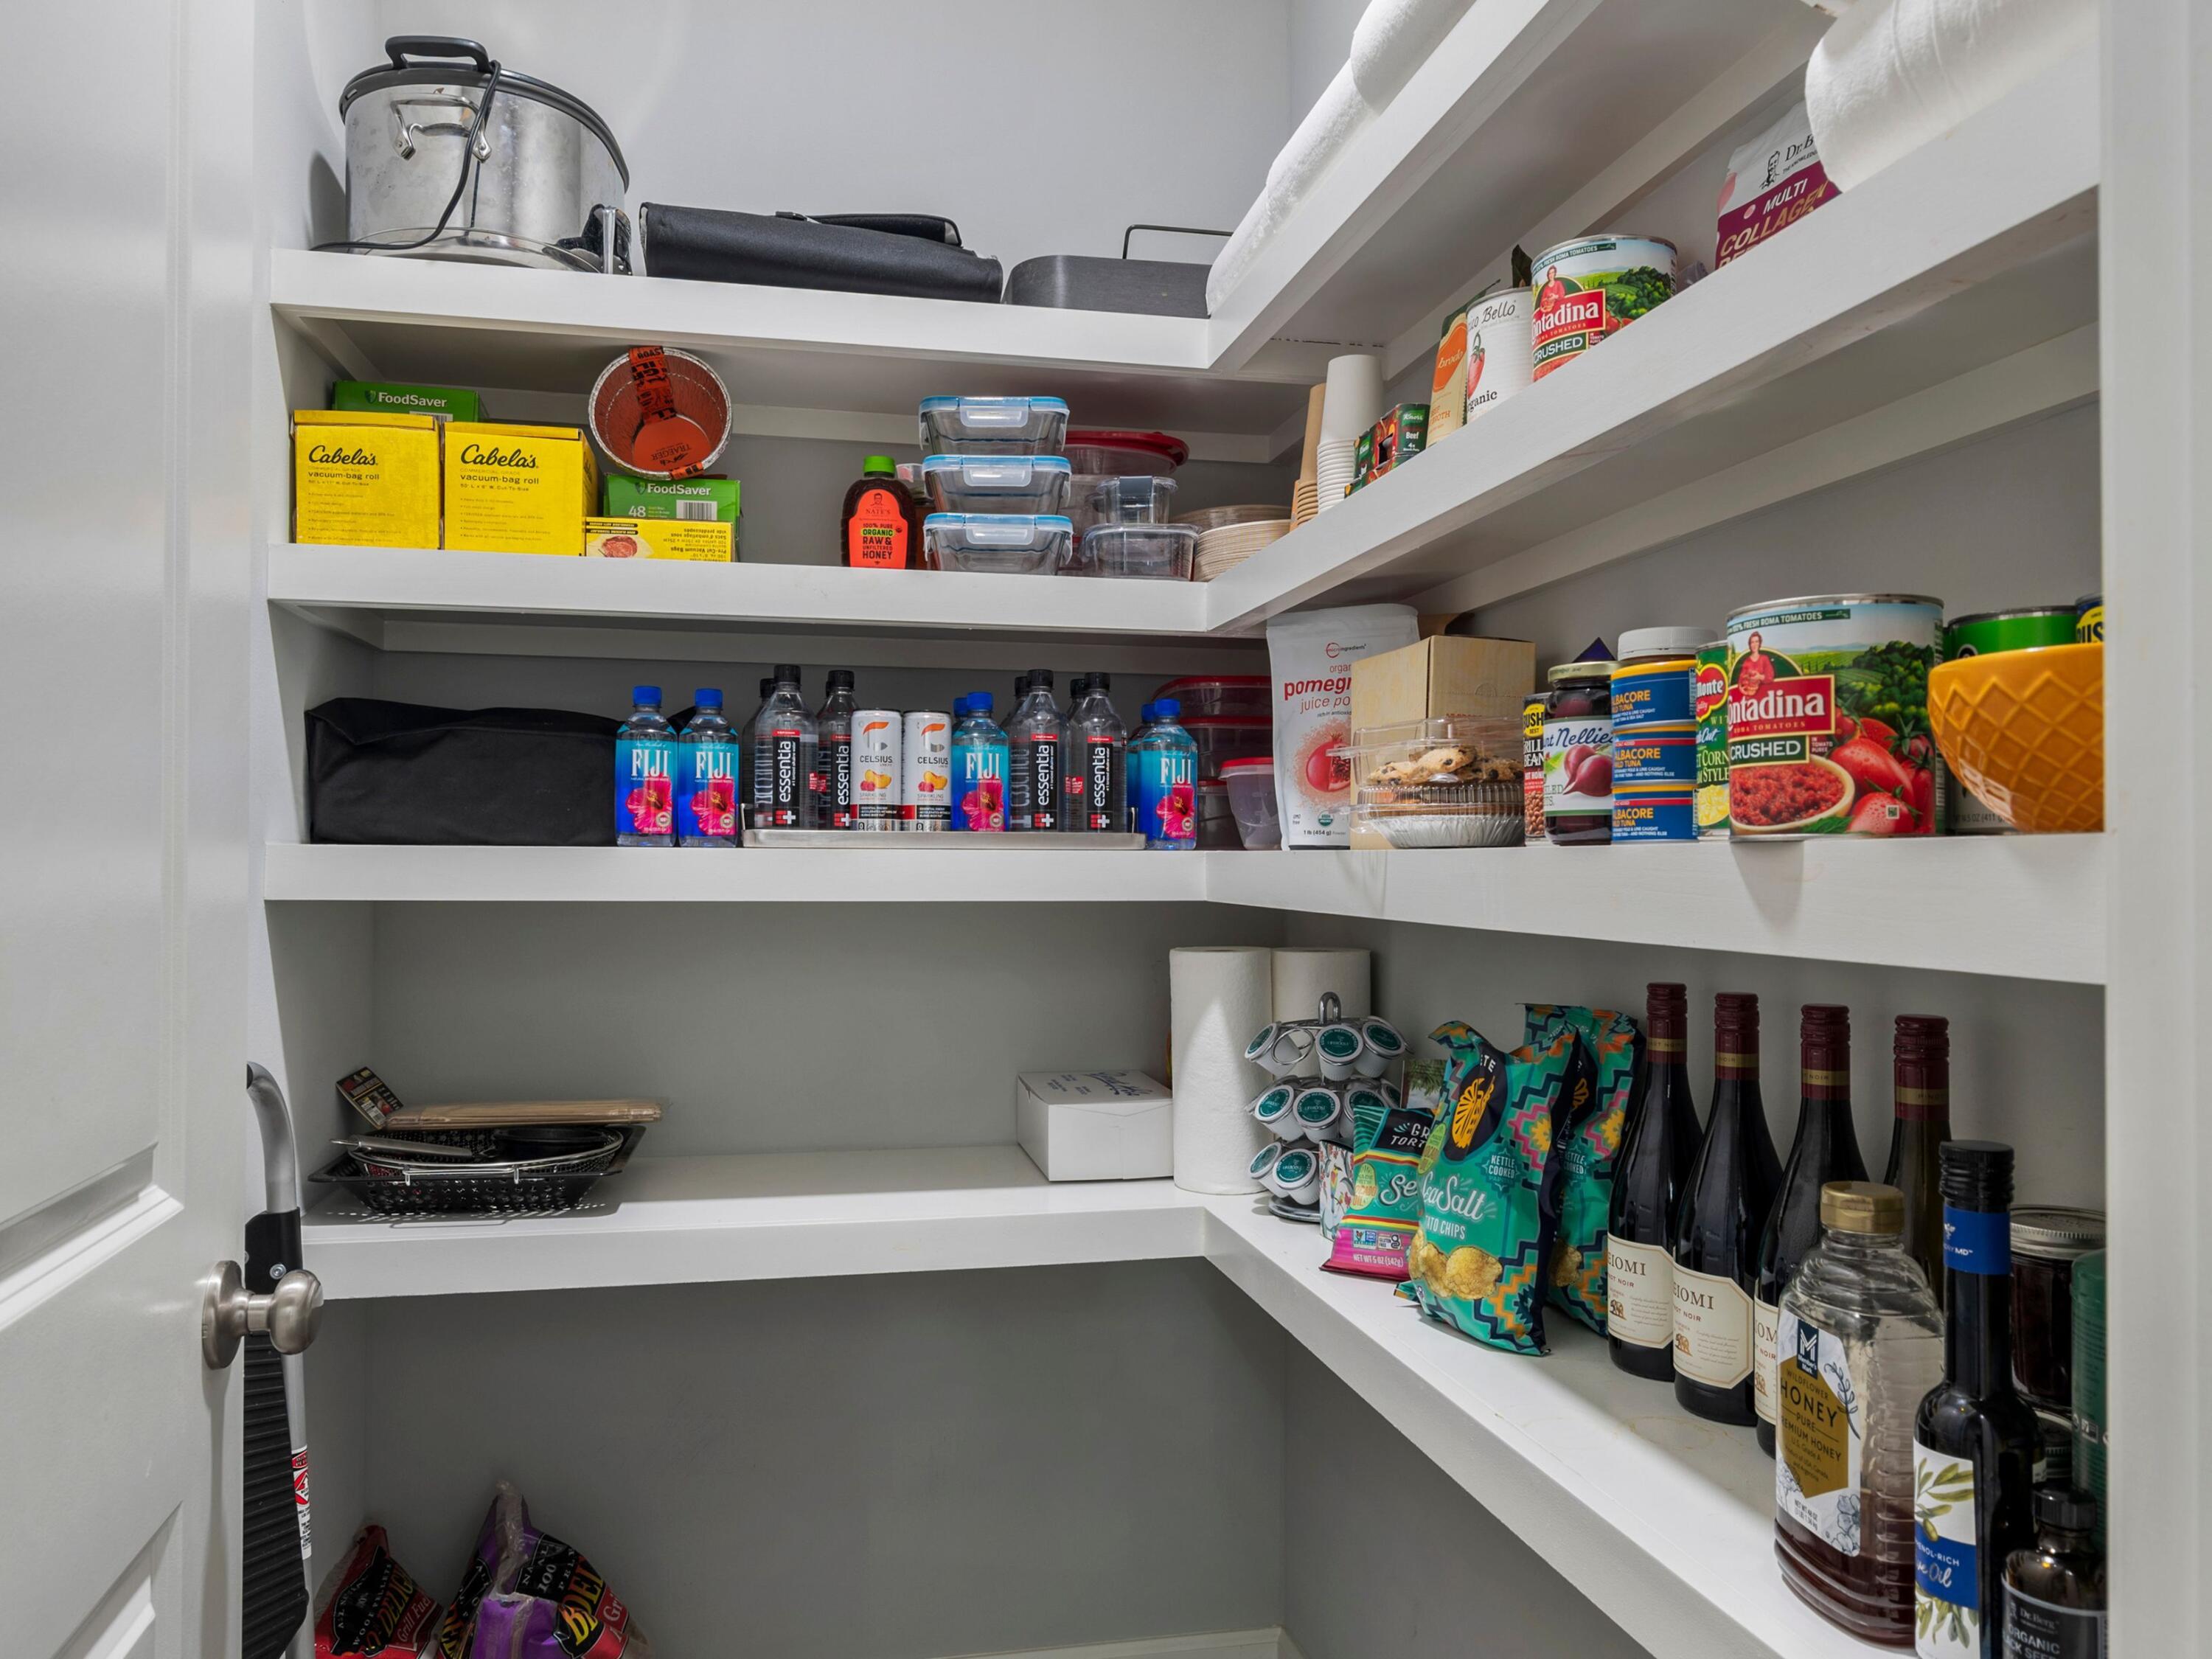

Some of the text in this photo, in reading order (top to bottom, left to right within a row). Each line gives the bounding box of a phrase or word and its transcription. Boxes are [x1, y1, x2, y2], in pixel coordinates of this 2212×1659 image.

[1784, 144, 1803, 162] Dr.
[1762, 178, 1808, 215] MULTI
[1569, 245, 1598, 257] TOMATOES
[1481, 301, 1516, 324] Bello
[636, 347, 665, 360] ROAST
[1534, 336, 1583, 364] CRUSHED
[378, 392, 448, 408] FoodSaver
[1402, 413, 1424, 421] Knorr
[1405, 431, 1419, 439] Beef
[308, 444, 377, 466] Cabela's
[460, 443, 537, 469] Cabela's
[650, 443, 692, 462] TRAEGER
[308, 470, 363, 481] vacuum-bag
[460, 474, 521, 485] vacuum-bag
[647, 482, 712, 496] FoodSaver
[628, 505, 647, 517] 48
[862, 528, 894, 537] ORGANIC
[862, 536, 892, 545] RAW &
[862, 550, 893, 560] HONEY
[1760, 616, 1779, 626] ROMA
[1781, 611, 1823, 623] TOMATOES
[1300, 696, 1330, 714] juice
[1753, 721, 1806, 731] TOMATOES
[859, 755, 893, 763] CELSIUS
[1730, 740, 1801, 761] CRUSHED
[631, 748, 669, 777] FIJI
[695, 751, 732, 779] FIJI
[917, 757, 949, 765] CELSIUS
[965, 752, 1000, 779] FIJI
[776, 740, 791, 802] essentia
[835, 745, 849, 805] essentia
[1035, 745, 1049, 806] essentia
[1092, 746, 1106, 807] essentia
[1160, 757, 1192, 785] FIJI
[1490, 1154, 1515, 1168] KETTLE
[1488, 1165, 1515, 1179] COOKED
[1436, 1175, 1486, 1220] Salt
[1439, 1220, 1466, 1240] CHIPS
[1353, 1253, 1404, 1268] NET WT 5 OZ (142g)
[1955, 1248, 1969, 1256] MD
[1618, 1277, 1635, 1288] NOIR
[1683, 1311, 1702, 1322] NOIR
[1759, 1348, 1776, 1361] NOIR
[1787, 1368, 1829, 1400] WILDFLOWER
[1781, 1376, 1838, 1428] HONEY
[1796, 1412, 1818, 1433] PURE
[1811, 1436, 1842, 1462] HONEY
[538, 1564, 557, 1593] 100
[1929, 1562, 1952, 1588] Oil
[397, 1595, 432, 1643] Grill Fuel
[2008, 1623, 2061, 1655] ORGANIC
